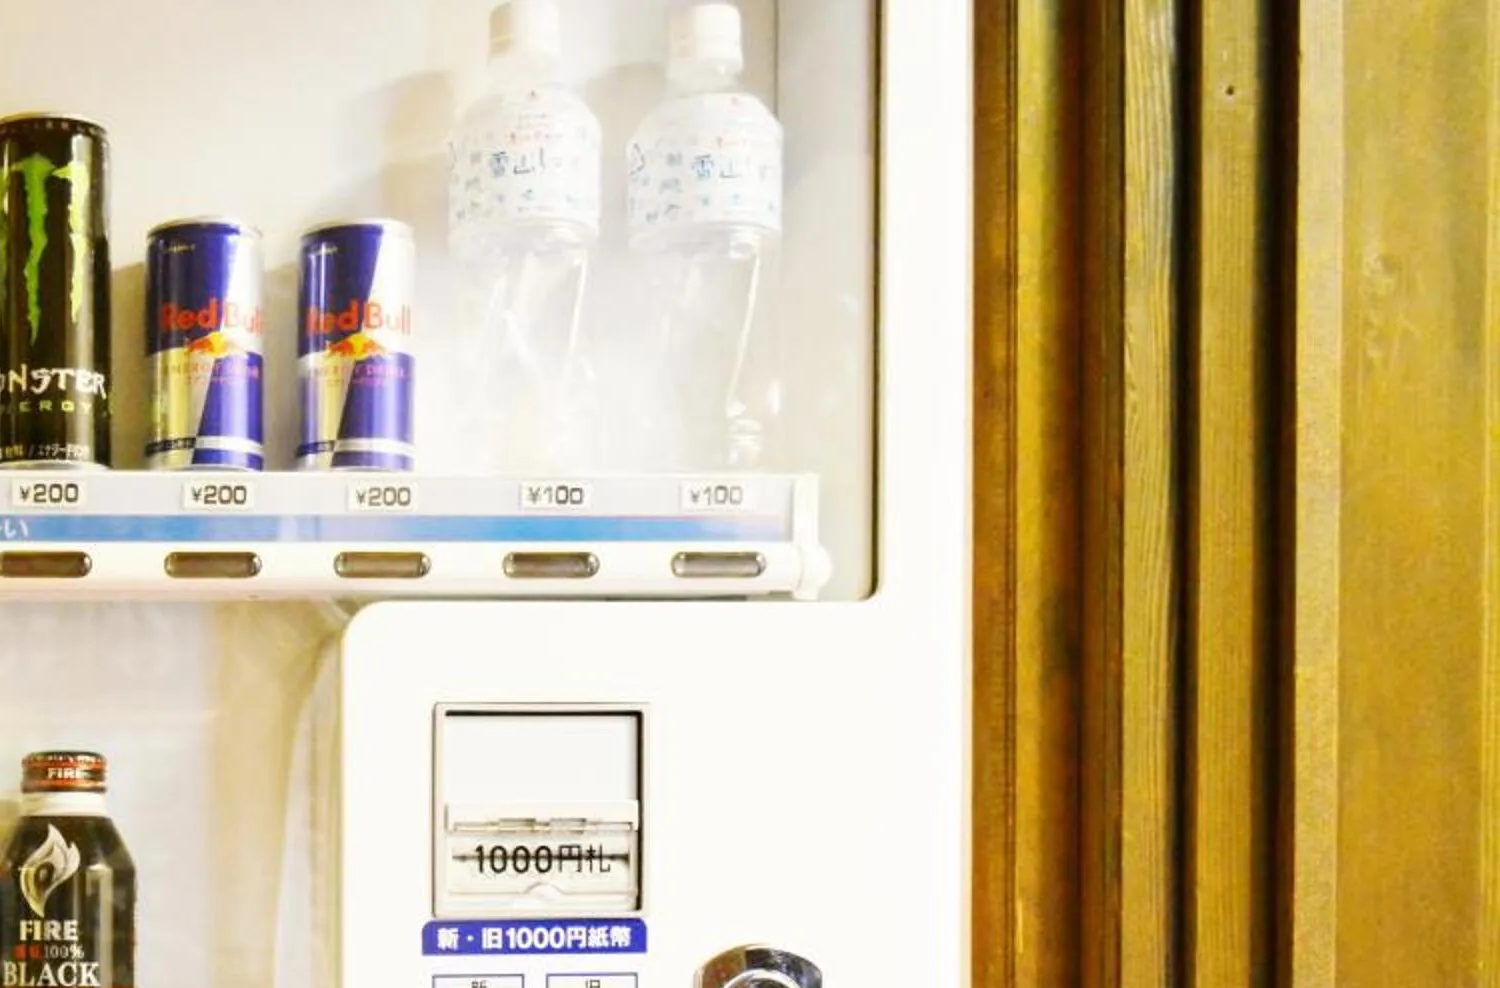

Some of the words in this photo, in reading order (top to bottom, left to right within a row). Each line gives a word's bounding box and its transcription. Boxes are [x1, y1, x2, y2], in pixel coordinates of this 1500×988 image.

[160, 297, 218, 332] Red
[307, 298, 358, 335] Red
[18, 483, 80, 504] ¥200
[191, 484, 248, 506] ¥200
[355, 486, 412, 507] ¥200
[528, 485, 584, 506] ¥100
[689, 485, 743, 506] ¥100
[474, 843, 611, 875] 1000円札
[20, 919, 79, 941] FIRE
[437, 925, 632, 951] 新・旧1000円紙幣
[3, 961, 101, 987] BLACK
